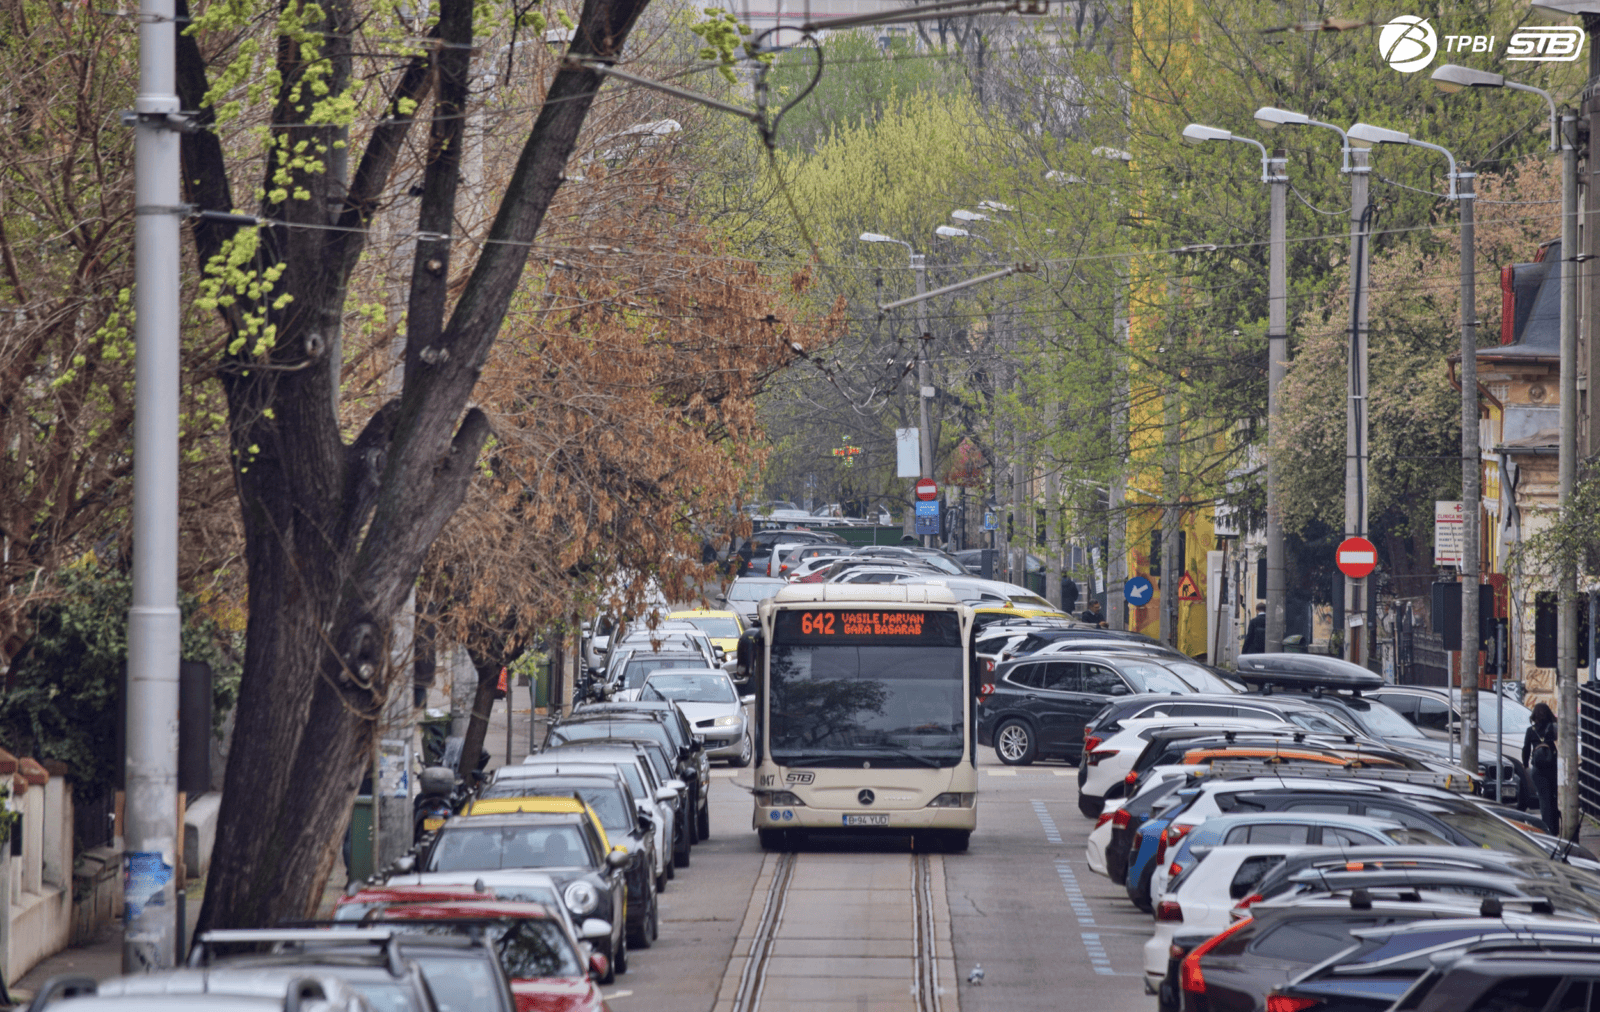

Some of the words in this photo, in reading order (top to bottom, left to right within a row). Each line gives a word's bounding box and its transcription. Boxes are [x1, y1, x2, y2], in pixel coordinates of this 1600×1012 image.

[802, 612, 835, 635] 642
[841, 613, 880, 624] VASILE
[882, 613, 925, 624] PARVAN
[844, 624, 872, 635] GARA
[874, 624, 922, 635] BASARAB
[786, 773, 813, 782] STB
